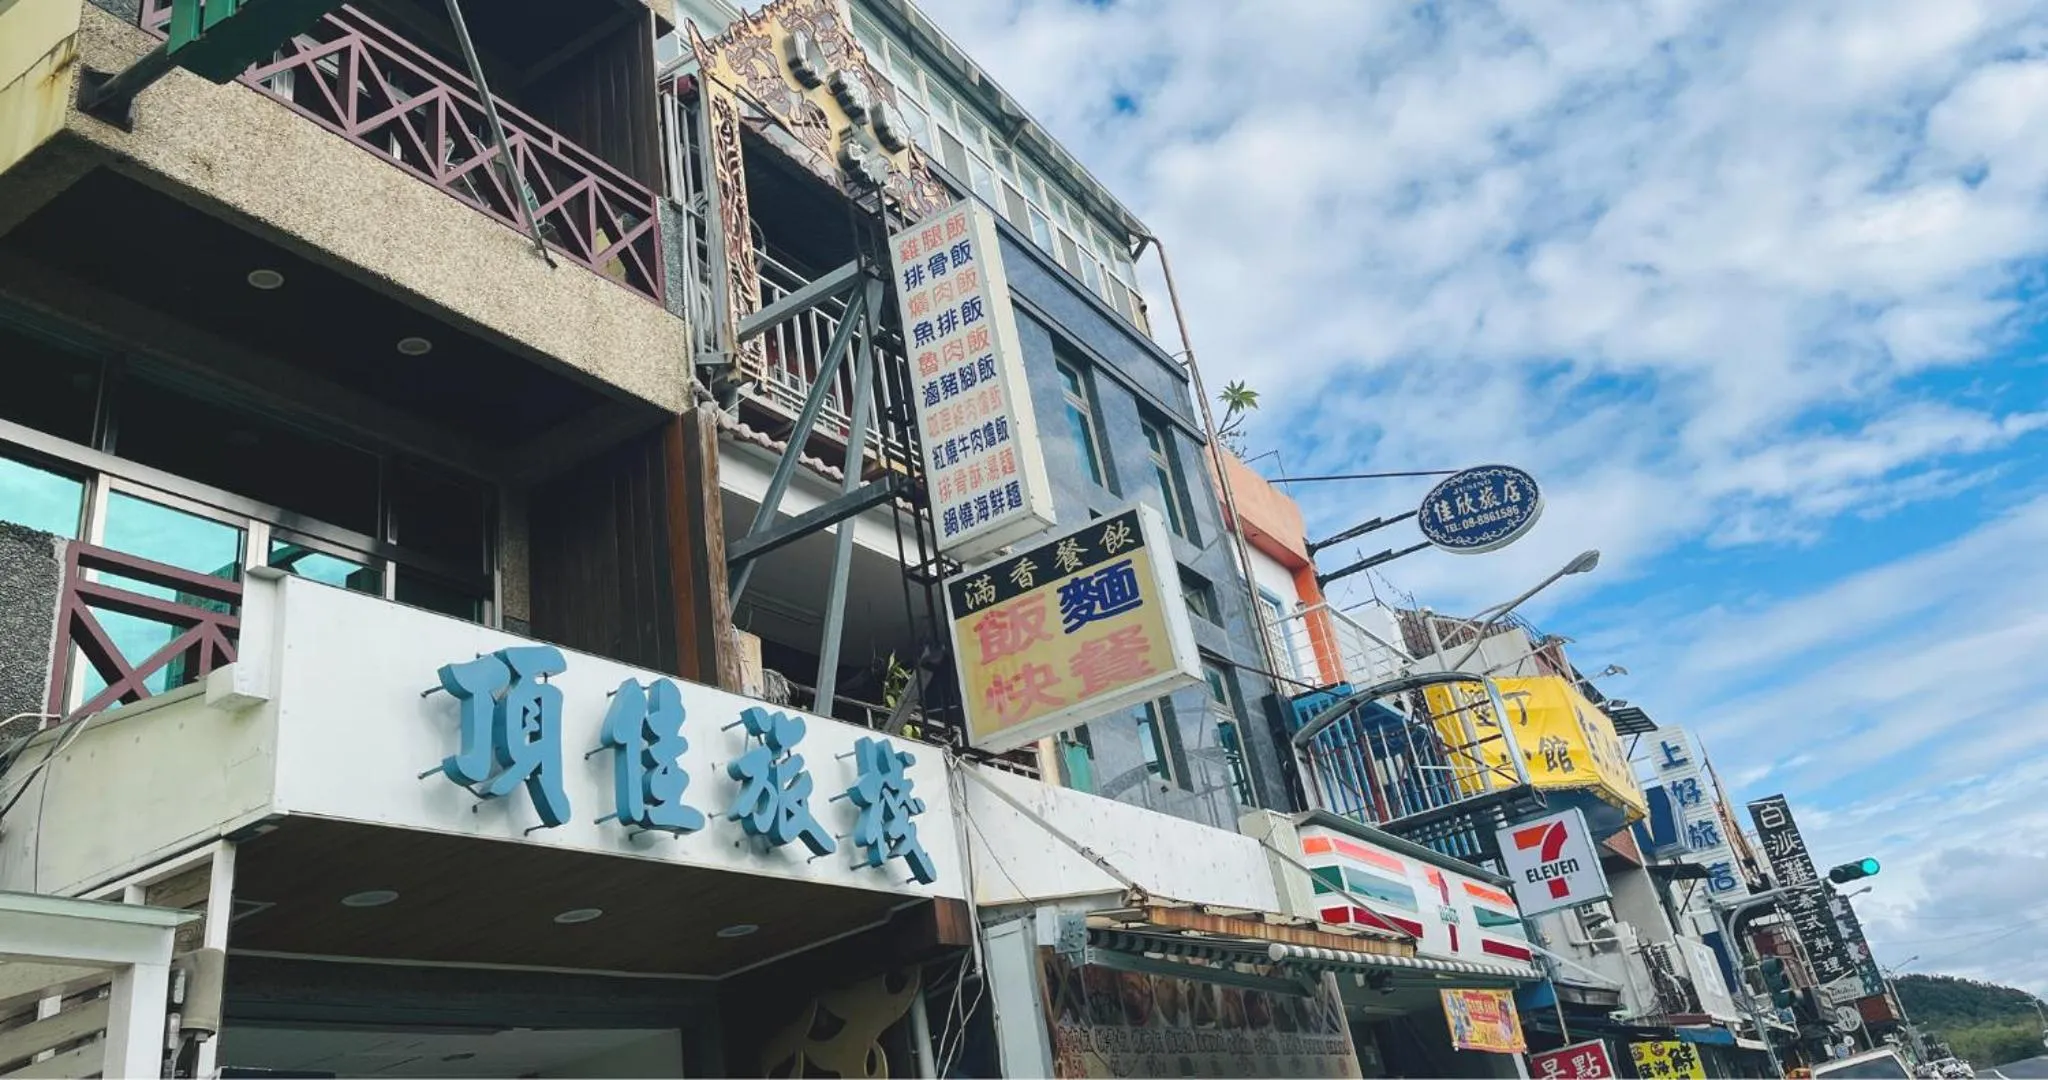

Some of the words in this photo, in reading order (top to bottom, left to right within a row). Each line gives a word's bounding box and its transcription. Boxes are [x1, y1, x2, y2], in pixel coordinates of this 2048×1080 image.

[903, 239, 974, 292] 排骨飯
[912, 296, 985, 349] 魚排飯
[918, 324, 991, 377] 魯肉飯
[931, 415, 1010, 470] 紅燒牛肉燴飯
[942, 480, 1023, 538] 鍋燒海鮮麵
[1433, 479, 1521, 523] 佳欣旅店
[965, 519, 1136, 611] 滿香餐飲
[984, 624, 1158, 725] 快餐
[437, 645, 937, 885] 頂佳旅棧
[1660, 740, 1737, 893] 上好旅店
[1541, 1051, 1601, 1080] 早點
